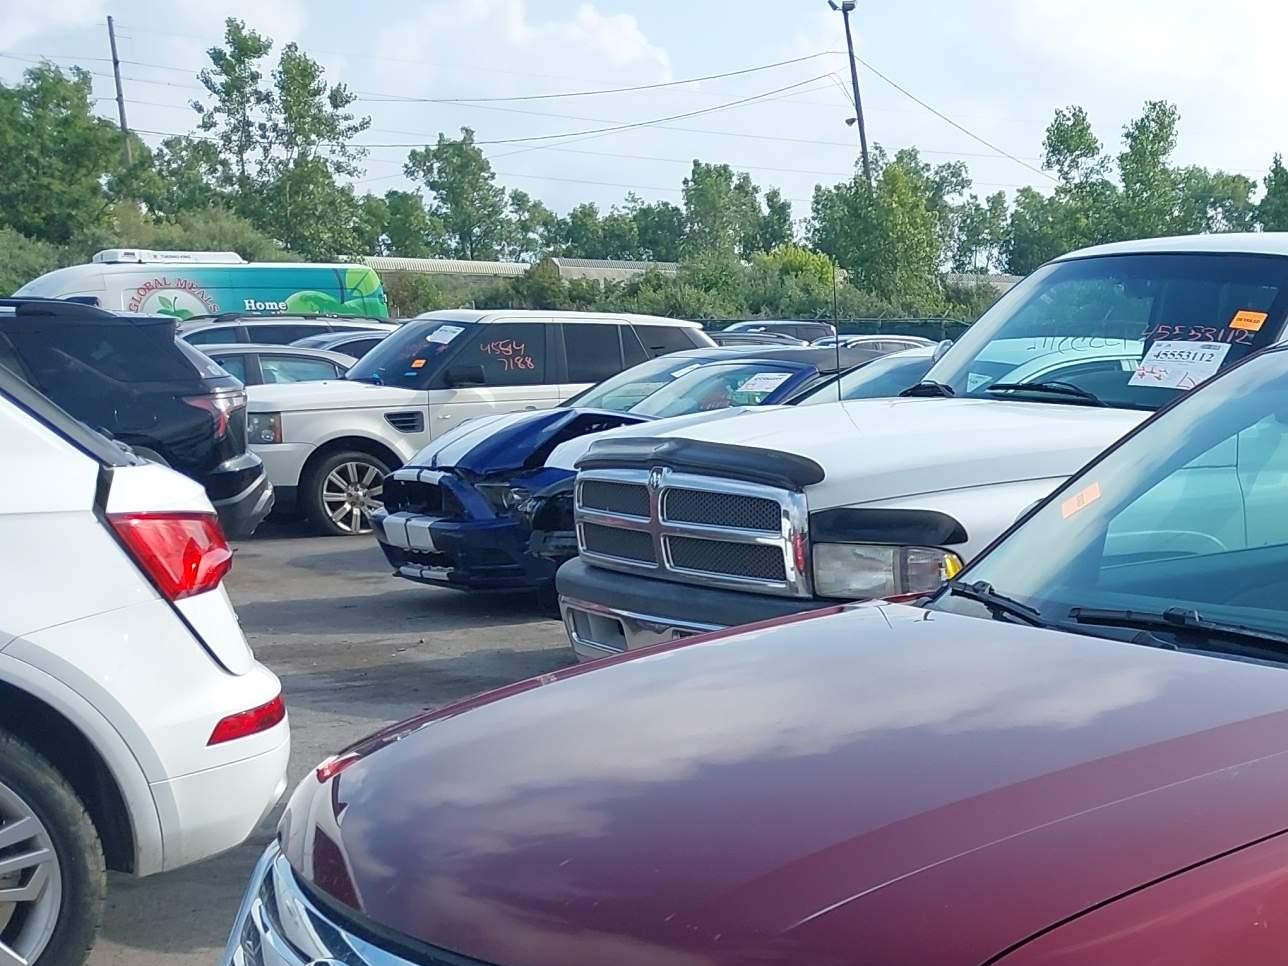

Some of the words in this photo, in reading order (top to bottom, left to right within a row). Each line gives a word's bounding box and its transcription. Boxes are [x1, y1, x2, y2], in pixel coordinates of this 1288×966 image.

[128, 277, 171, 313] GLOBAL
[244, 299, 287, 311] Home
[1153, 350, 1215, 362] 45553112
